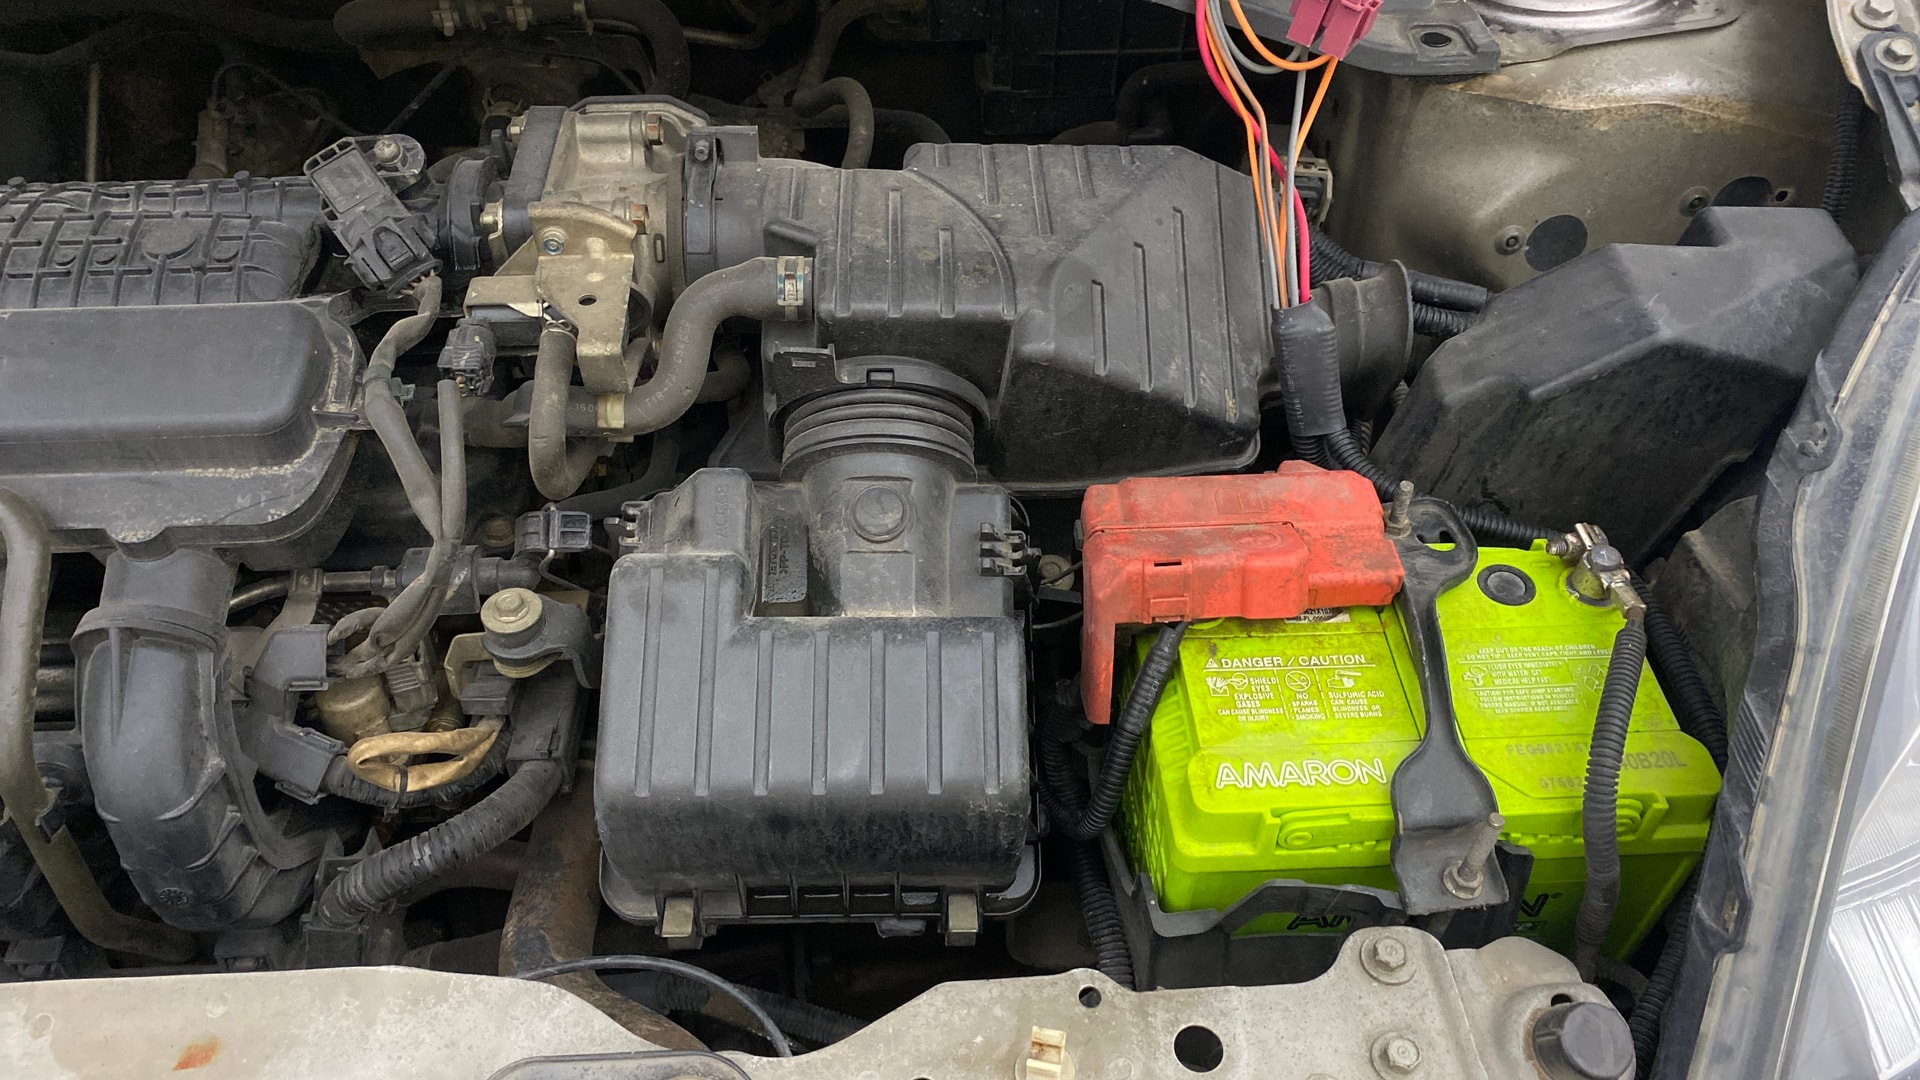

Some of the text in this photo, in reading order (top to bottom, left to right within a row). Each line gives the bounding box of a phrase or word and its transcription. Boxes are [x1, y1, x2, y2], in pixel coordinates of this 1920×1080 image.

[1221, 654, 1366, 669] DANGER / CAUTION
[1249, 677, 1276, 685] SHIELD
[1493, 678, 1520, 686] MEDICAL
[1251, 684, 1271, 692] EYES
[1234, 692, 1275, 700] EXPLOSIVE
[1296, 692, 1309, 700] NO
[1328, 690, 1385, 699] SULFURIC ACID
[1236, 700, 1261, 708] GASES
[1330, 698, 1344, 706] CAN
[1217, 707, 1284, 716] CAN CAUSE BLINDNESS
[1332, 704, 1368, 712] BLINDNESS
[1334, 710, 1383, 720] SEVERE BURNS
[1216, 757, 1387, 789] AMARON
